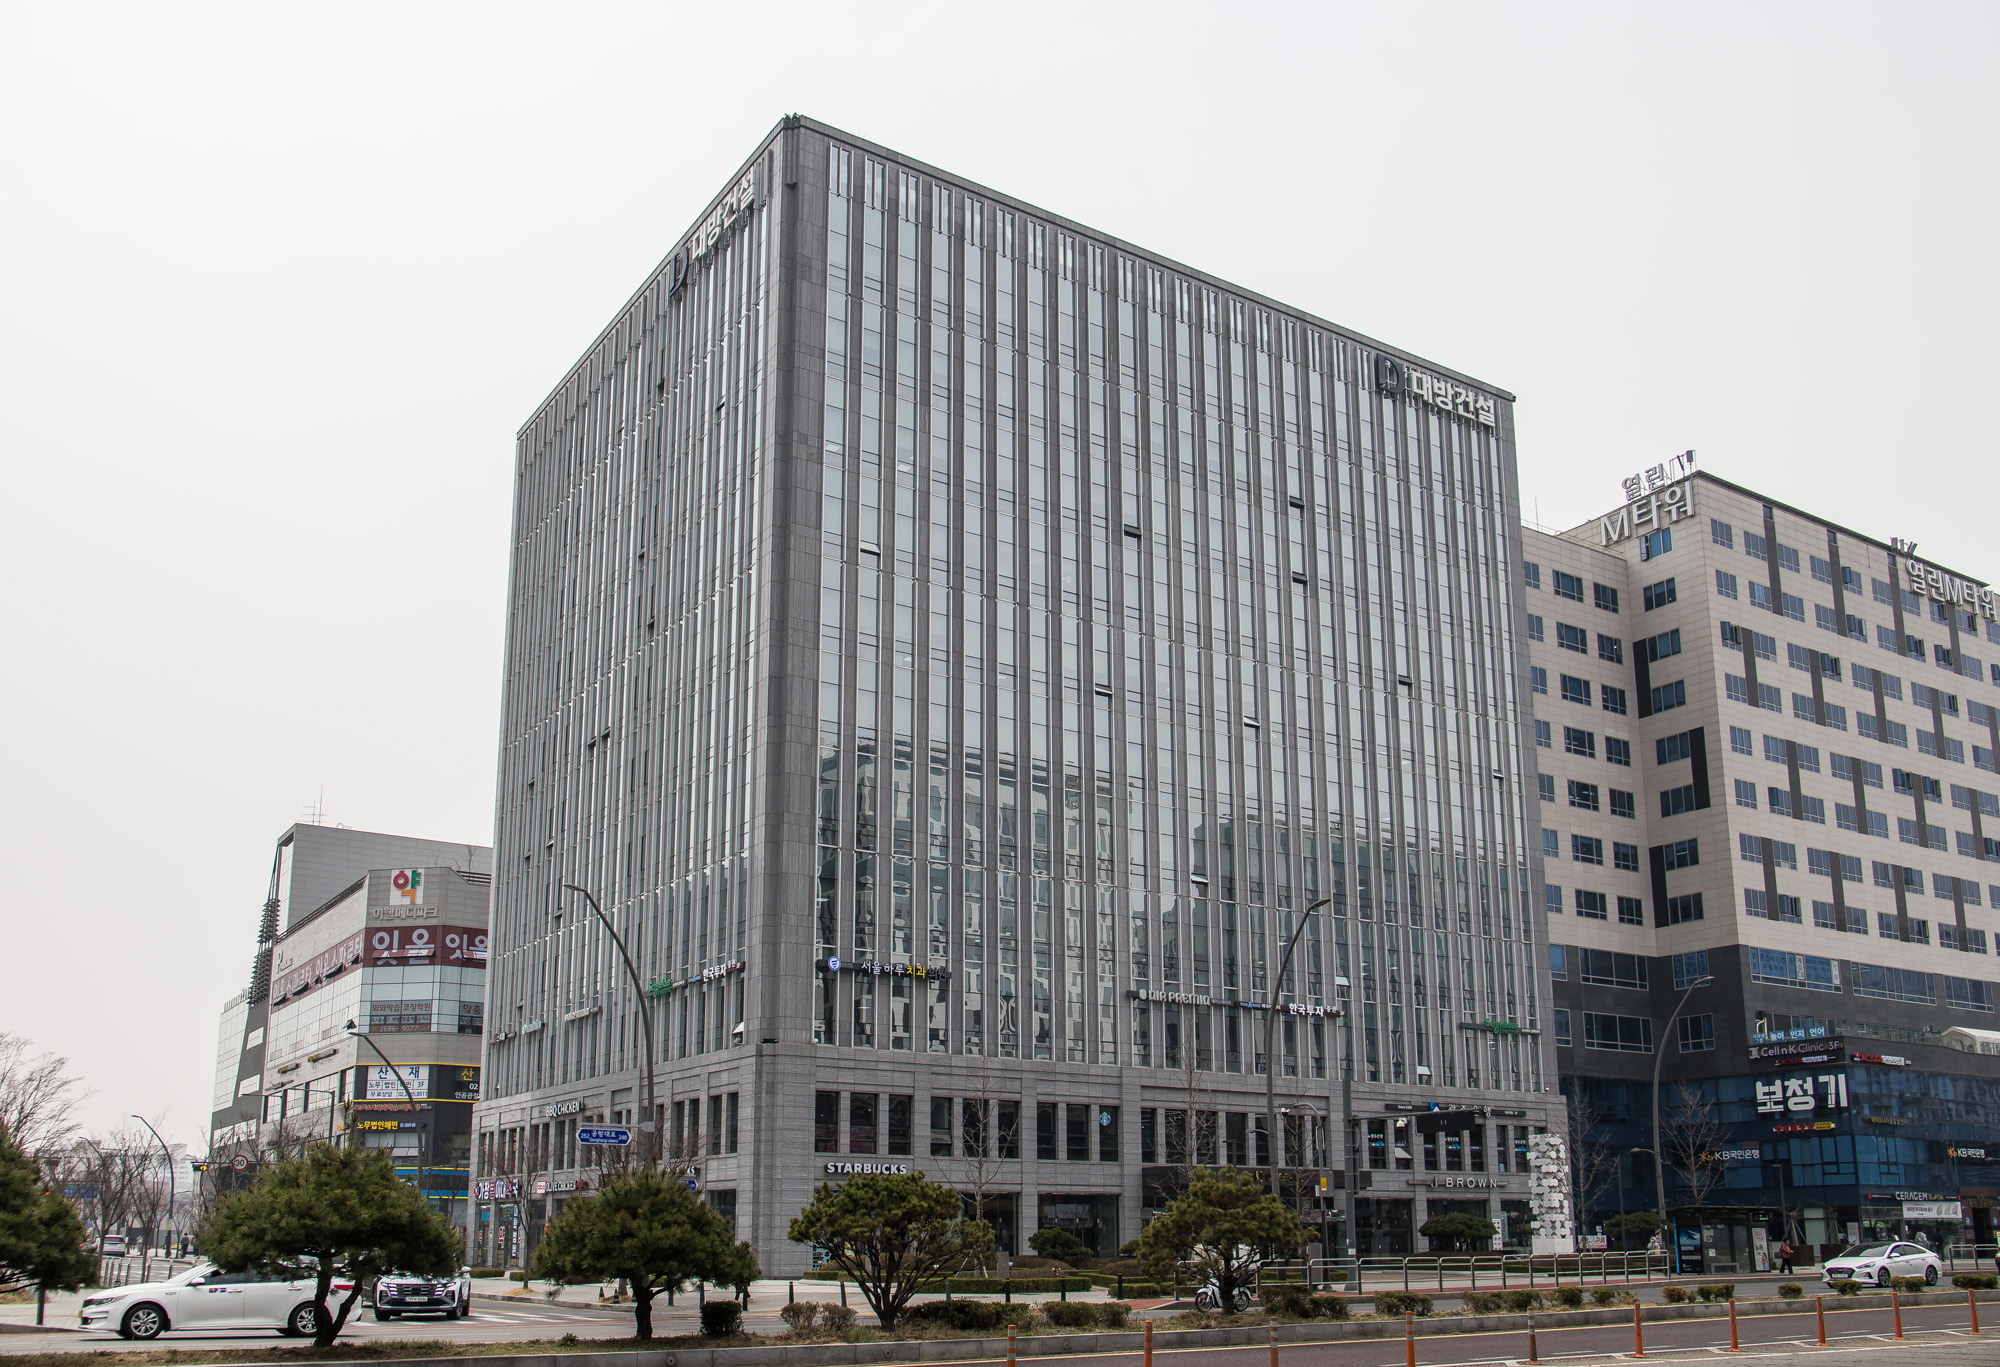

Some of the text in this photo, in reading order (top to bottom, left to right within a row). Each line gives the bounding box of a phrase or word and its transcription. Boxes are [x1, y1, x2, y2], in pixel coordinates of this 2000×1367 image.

[692, 166, 754, 260] 대방건설
[1412, 369, 1495, 427] 대방건설
[1622, 463, 1663, 500] 열린
[1600, 480, 1694, 546] M타워
[1906, 560, 1997, 622] 열린M타워
[393, 870, 421, 903] 약
[403, 1002, 431, 1012] 코칭학원
[1485, 1018, 1519, 1029] Schneider
[1770, 1027, 1825, 1041] 놀이 인지 언어
[1761, 1046, 1780, 1057] Cell
[1789, 1044, 1797, 1053] K
[1798, 1042, 1824, 1053] Clinic
[1828, 1041, 1840, 1050] 3F
[462, 1067, 474, 1080] 산
[1756, 1073, 1848, 1112] 보청기
[557, 1100, 580, 1115] CHICKEN
[357, 1121, 398, 1130] 노무법인해민
[591, 1130, 616, 1138] 공항대로
[1715, 1149, 1759, 1160] KB국민은행
[234, 1159, 245, 1167] 30
[827, 1162, 907, 1174] STARBUCKS
[1431, 1176, 1497, 1188] J BROWN
[1895, 1191, 1928, 1200] CERAGEM
